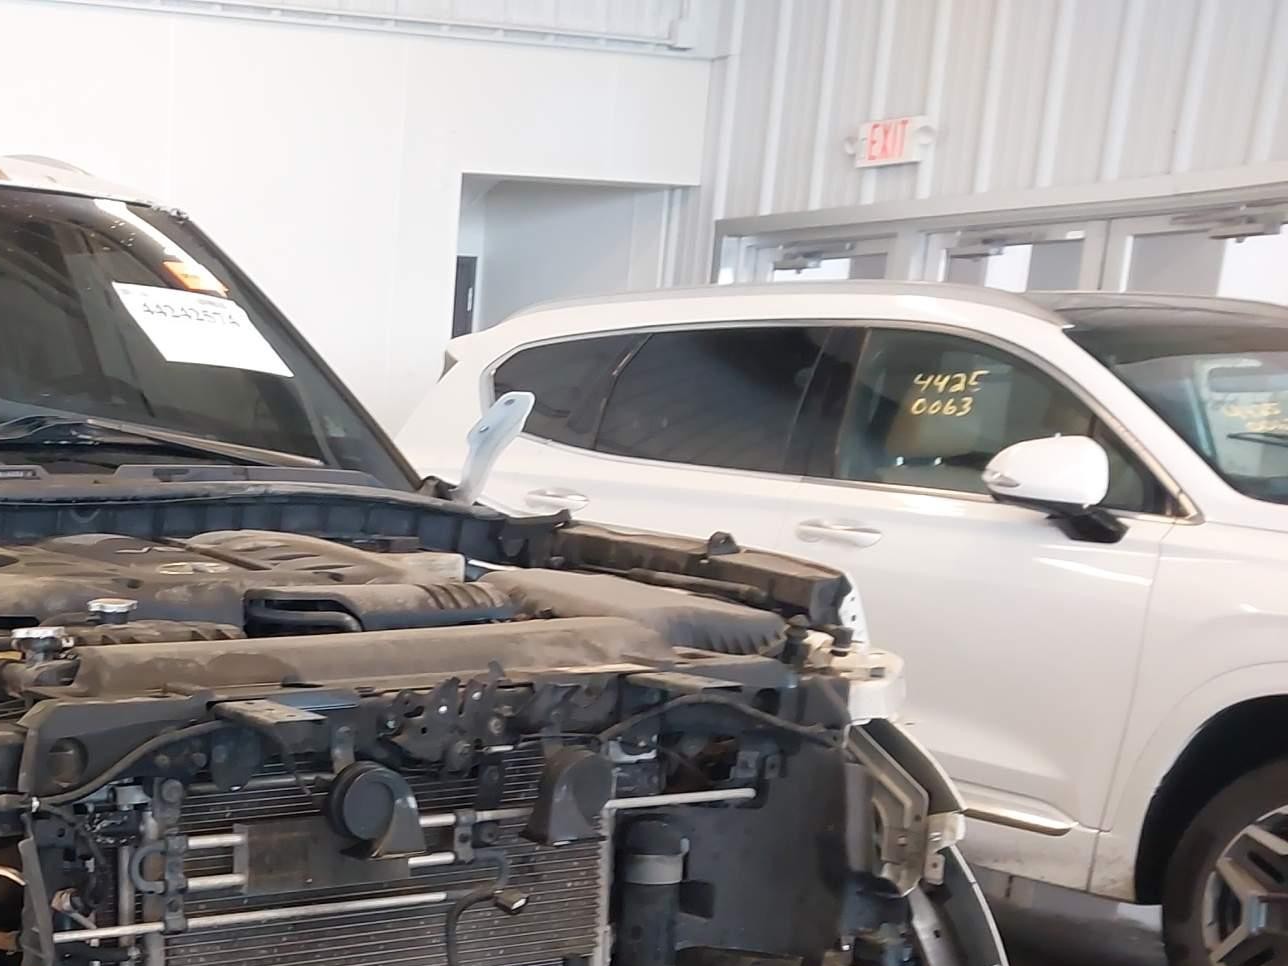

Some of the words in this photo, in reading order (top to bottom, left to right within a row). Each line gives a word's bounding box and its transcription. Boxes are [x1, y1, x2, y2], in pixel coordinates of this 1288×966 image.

[866, 118, 910, 161] EXIT
[913, 369, 991, 393] 4425
[911, 396, 974, 417] 0063
